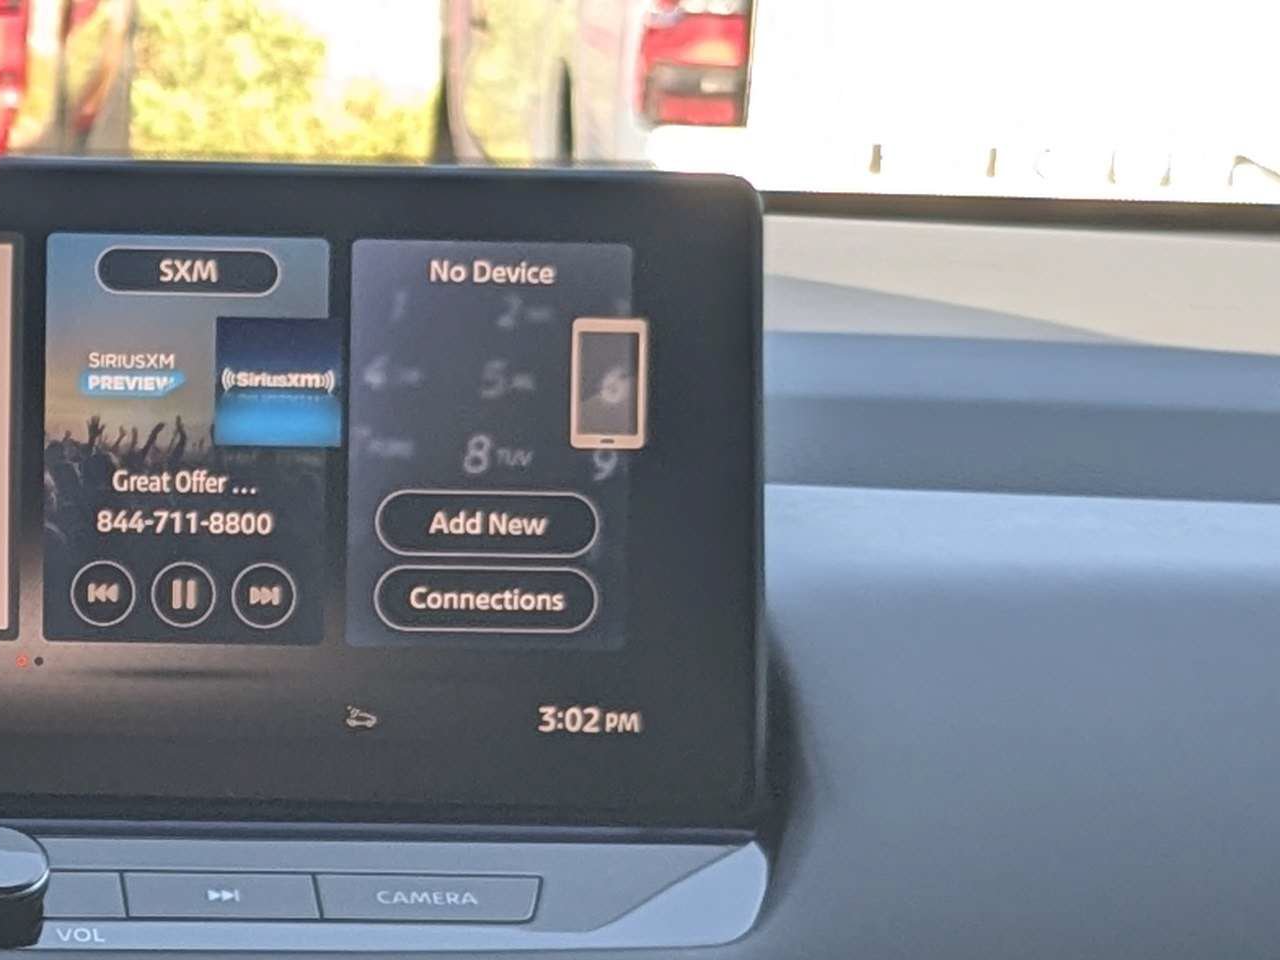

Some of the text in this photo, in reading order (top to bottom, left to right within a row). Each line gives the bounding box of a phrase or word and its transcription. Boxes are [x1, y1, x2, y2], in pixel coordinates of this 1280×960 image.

[159, 259, 219, 283] SXM
[429, 259, 556, 285] No Device
[88, 352, 175, 369] SIRIUSXM
[88, 374, 174, 391] PREVIEW
[464, 434, 491, 474] 8
[112, 470, 171, 493] Great
[175, 471, 227, 494] Offer
[96, 510, 273, 535] 844-711-8800
[428, 511, 547, 536] Add New
[409, 586, 565, 612] Connections
[538, 705, 641, 733] 3:02 PM
[376, 890, 479, 905] CAMERA
[56, 927, 105, 942] VOL
